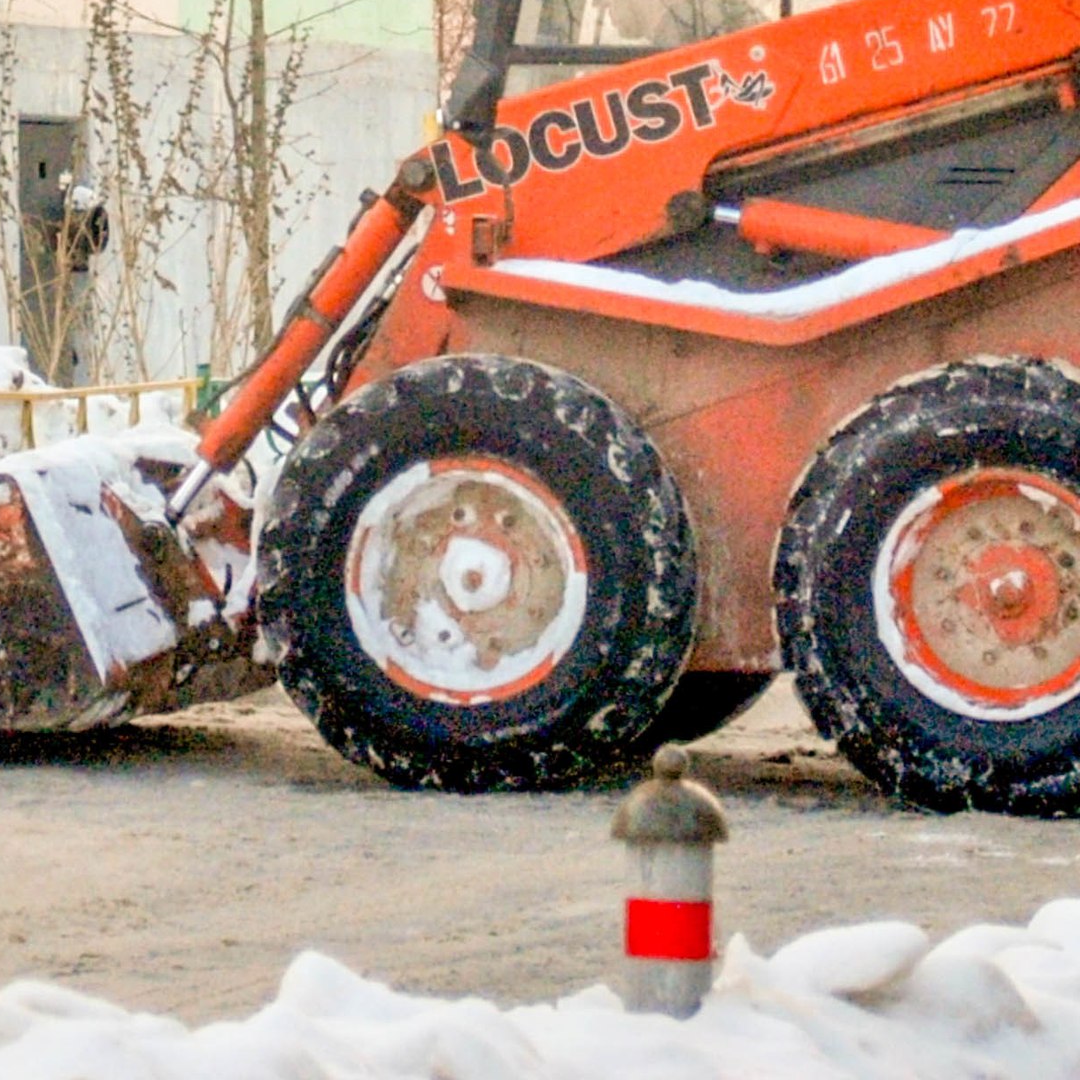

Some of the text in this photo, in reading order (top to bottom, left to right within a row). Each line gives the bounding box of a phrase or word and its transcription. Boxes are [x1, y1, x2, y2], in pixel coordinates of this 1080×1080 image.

[865, 25, 904, 70] 25
[980, 1, 1015, 38] 77
[429, 61, 717, 204] LOCUST
